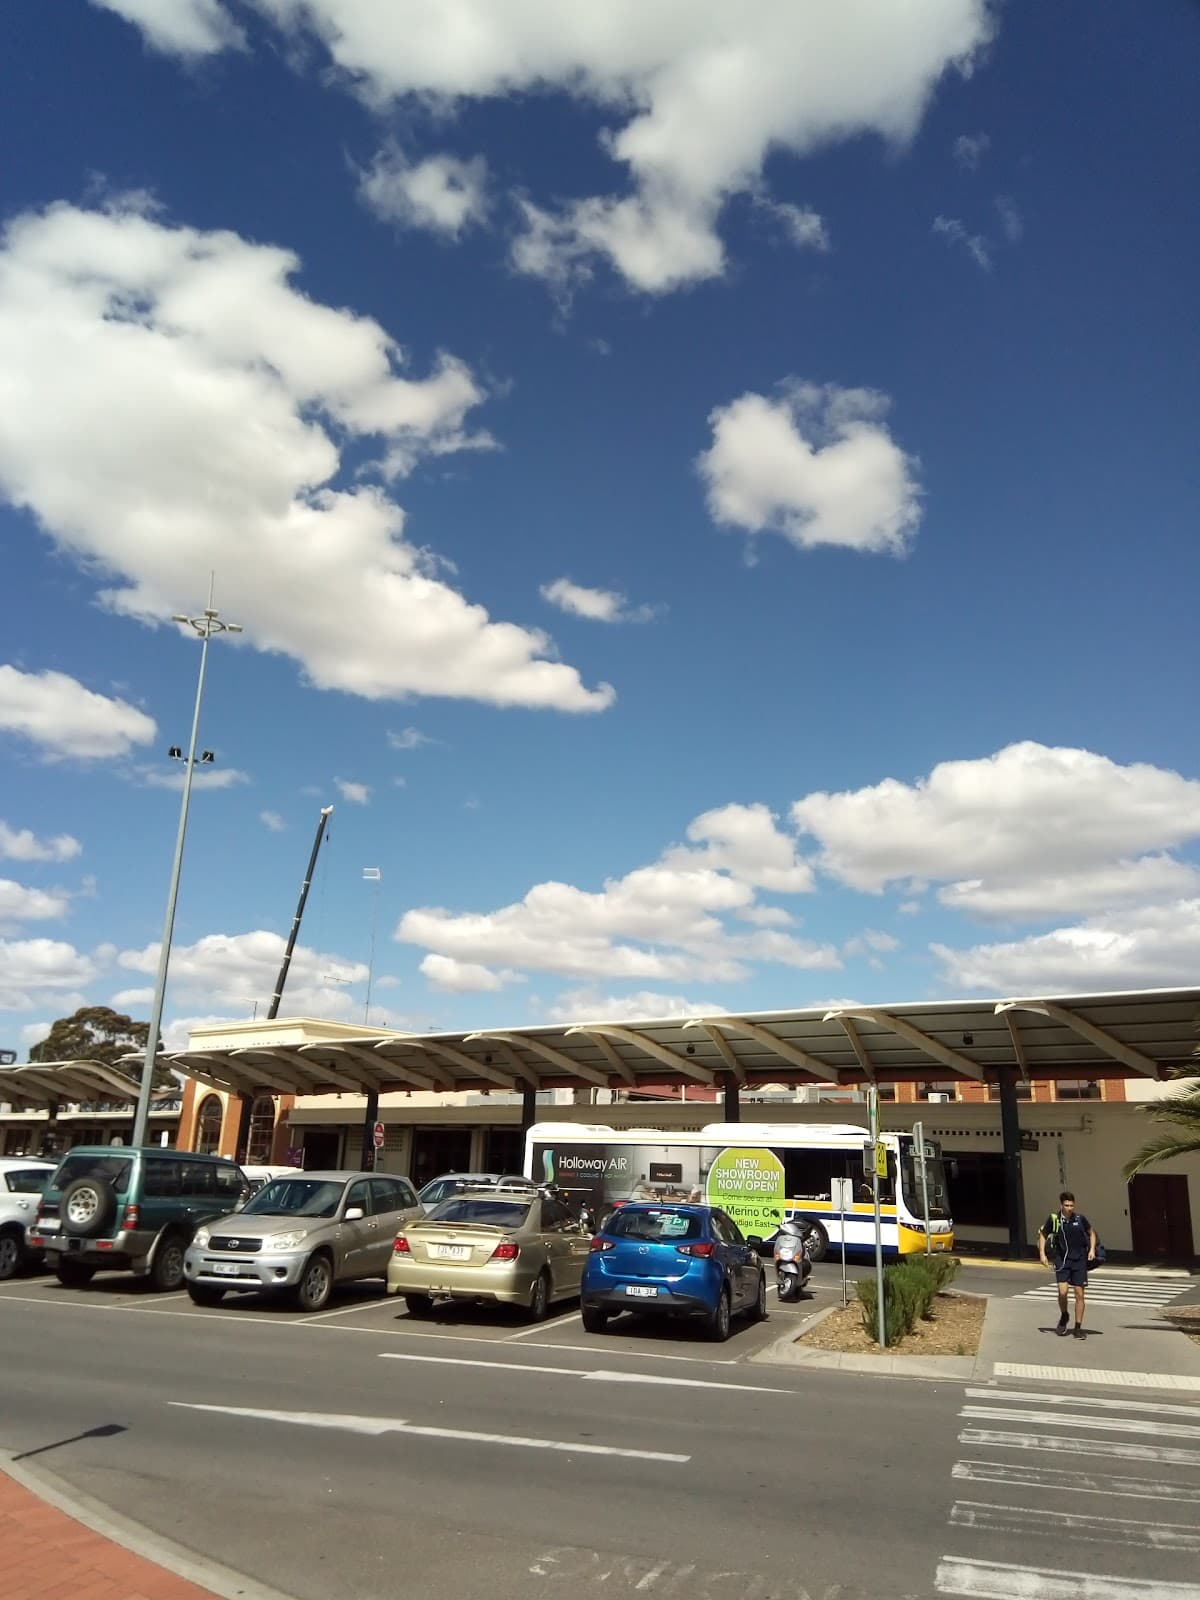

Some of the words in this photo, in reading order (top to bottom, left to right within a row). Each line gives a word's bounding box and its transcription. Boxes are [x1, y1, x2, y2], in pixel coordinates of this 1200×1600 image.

[558, 1156, 608, 1172] Holloway
[608, 1158, 627, 1170] AIR
[735, 1158, 759, 1169] NEW
[715, 1168, 780, 1181] SHOWROOM
[718, 1180, 742, 1190] NOW
[745, 1181, 778, 1192] OPEN!
[726, 1205, 760, 1217] Merino
[754, 1220, 770, 1228] East
